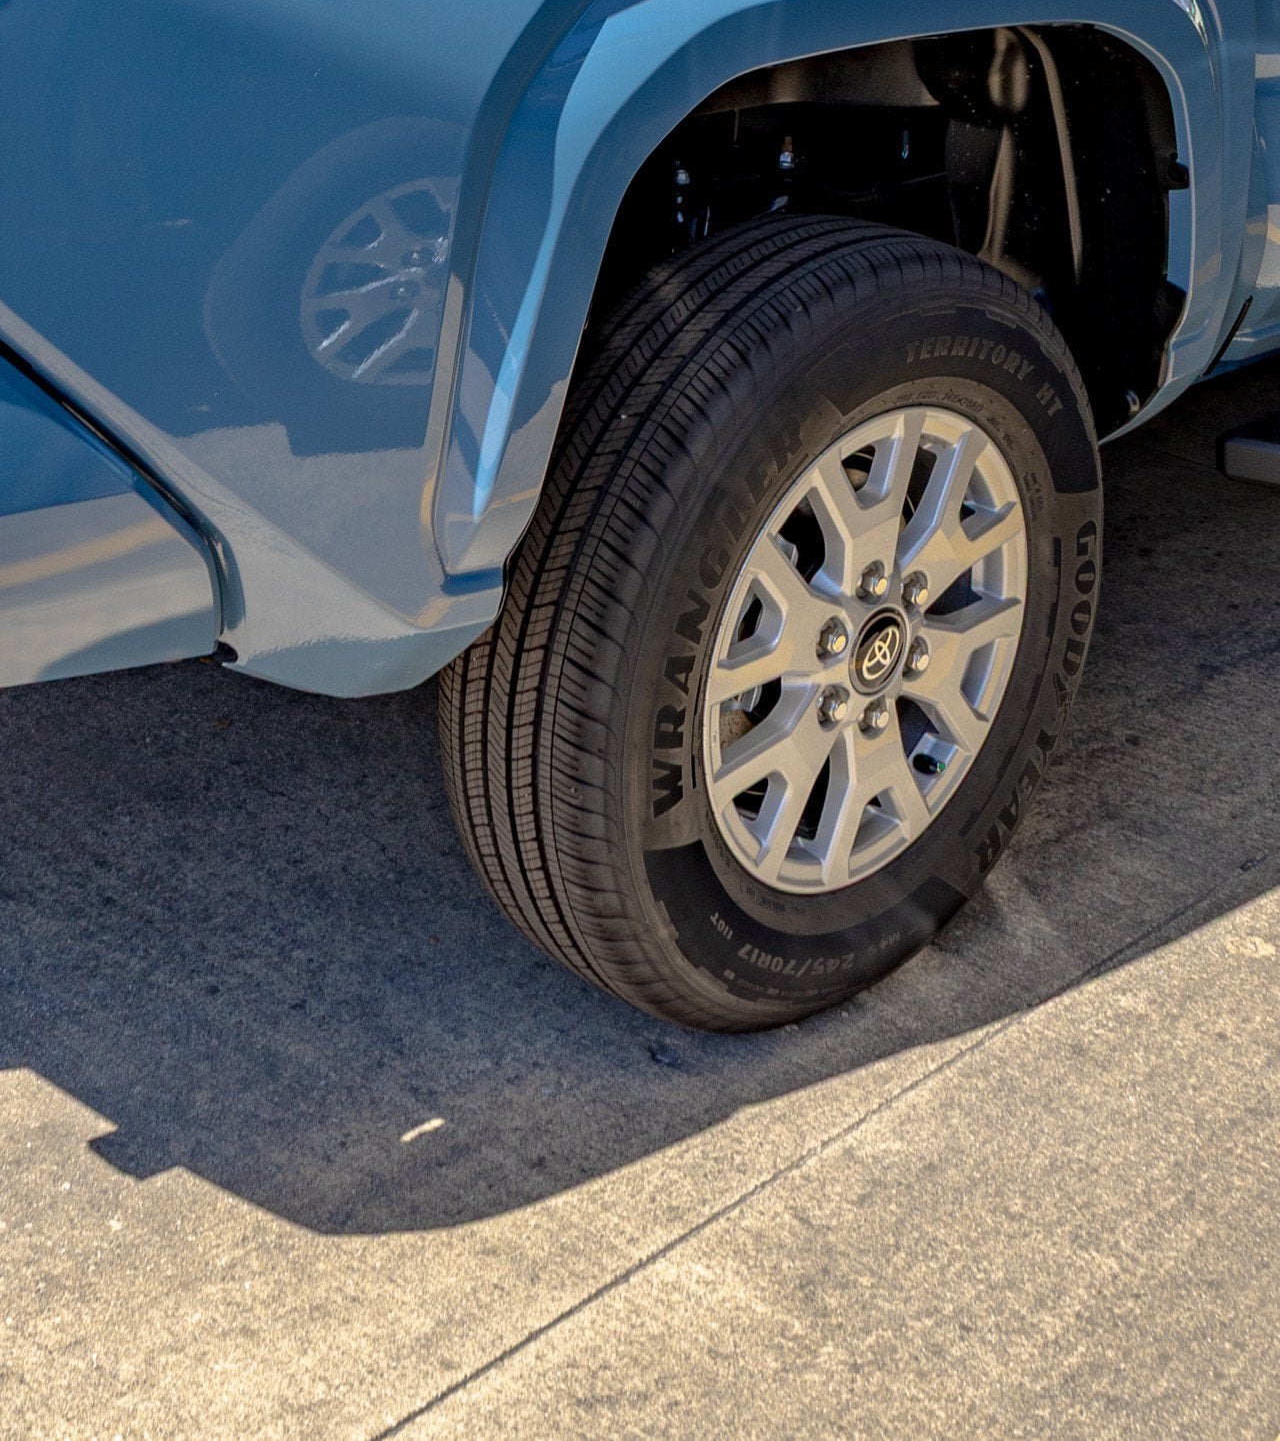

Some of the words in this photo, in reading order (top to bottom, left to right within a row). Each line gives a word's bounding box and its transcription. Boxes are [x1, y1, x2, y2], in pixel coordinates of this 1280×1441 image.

[906, 335, 1034, 381] TERRITORY
[1035, 381, 1064, 417] HT
[652, 416, 803, 819] WRANGLER
[974, 519, 1098, 873] GOODYEAR
[736, 941, 854, 978] 245/70R17
